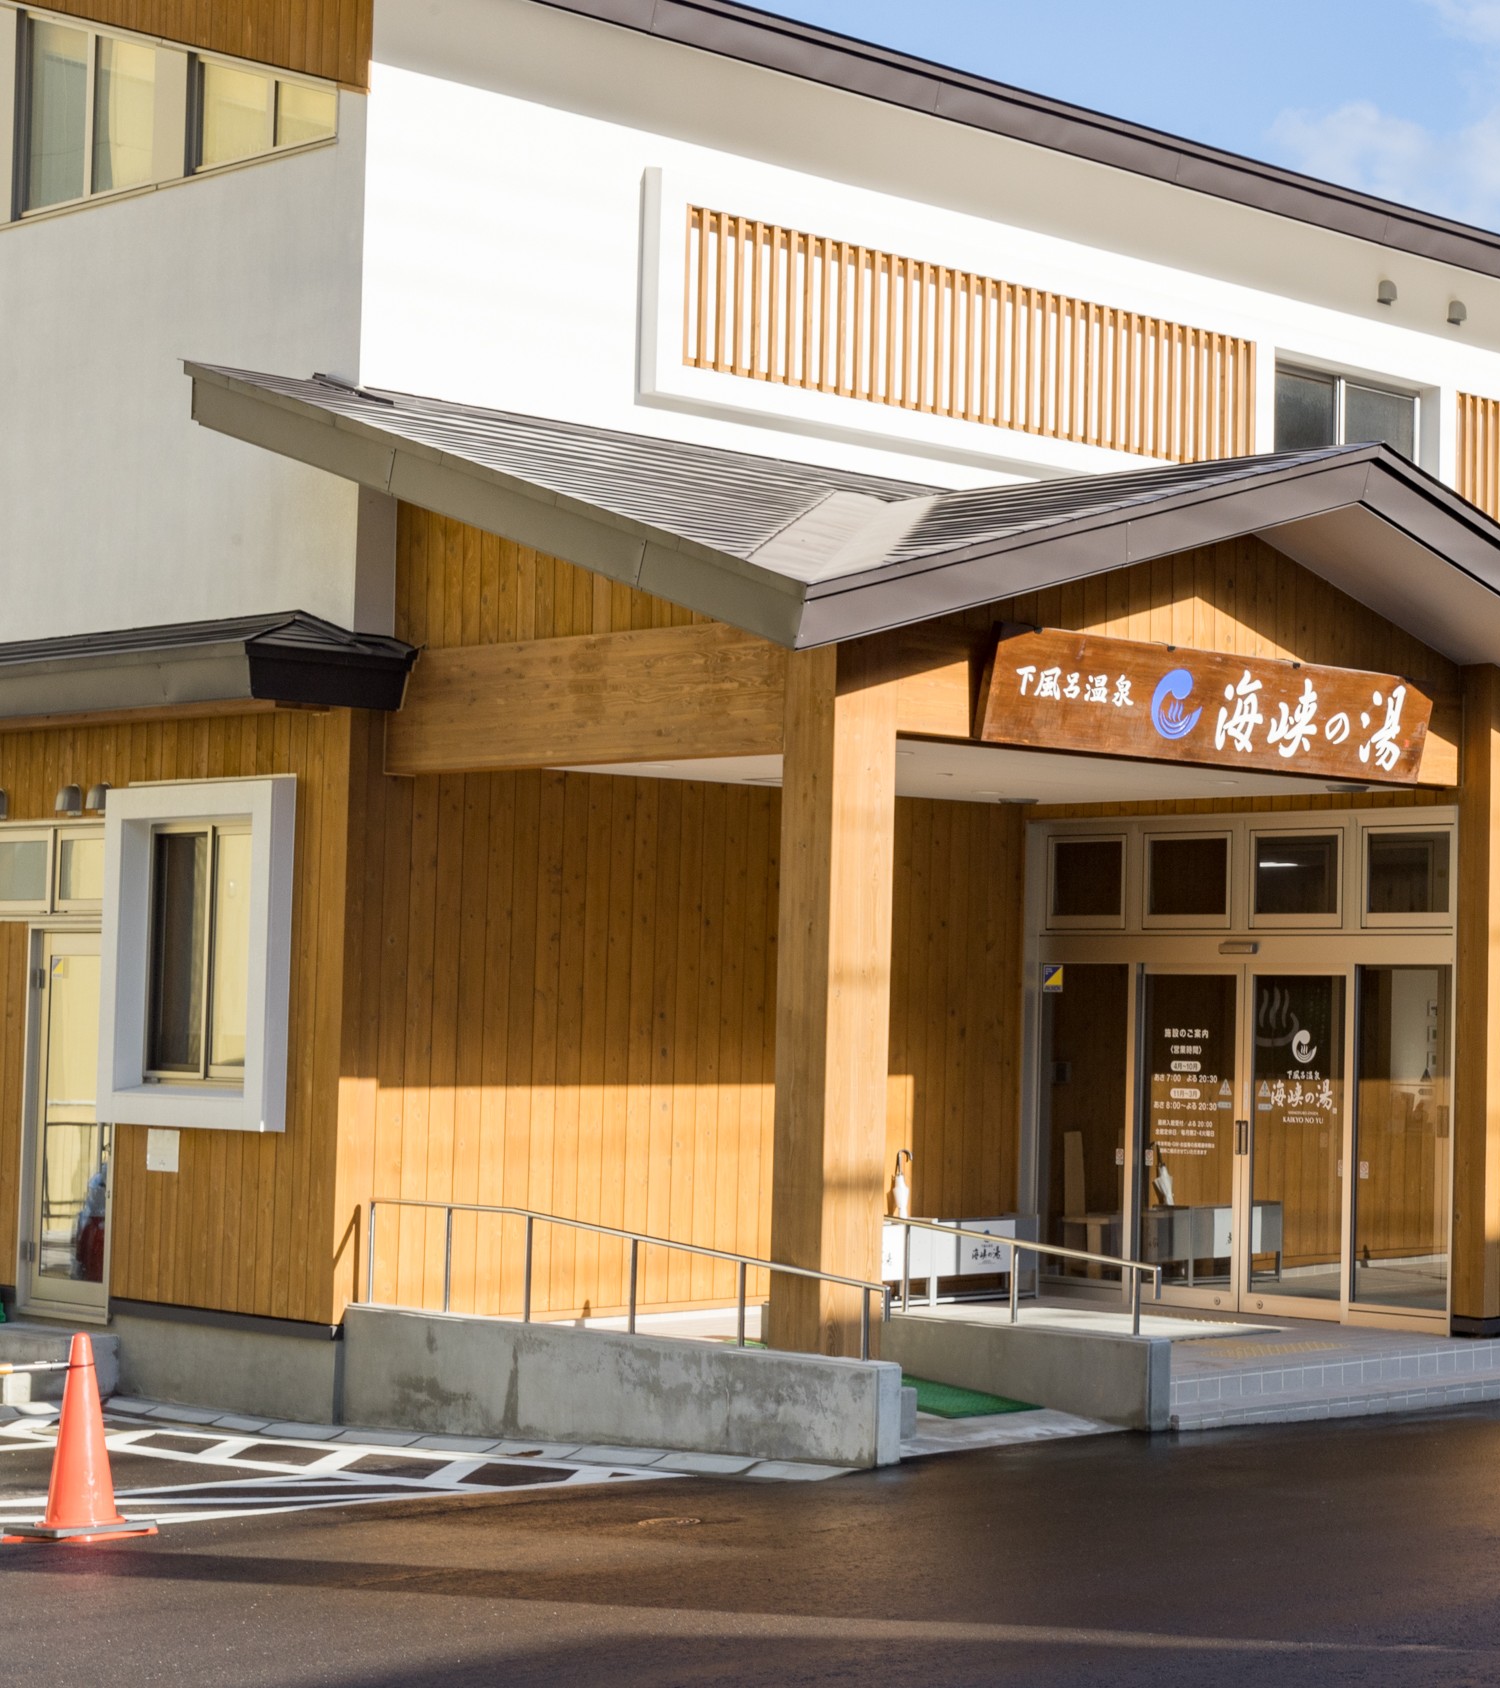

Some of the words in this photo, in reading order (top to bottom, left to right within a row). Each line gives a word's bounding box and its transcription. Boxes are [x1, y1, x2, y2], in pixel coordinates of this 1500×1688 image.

[1015, 665, 1134, 708] 下風呂温泉
[1214, 669, 1407, 772] 海峡の湯
[1164, 1028, 1209, 1039] 施設のご案内
[1271, 1079, 1333, 1110] 海峡の湯
[1282, 1116, 1304, 1124] KAIKYO
[1304, 1116, 1315, 1124] NO
